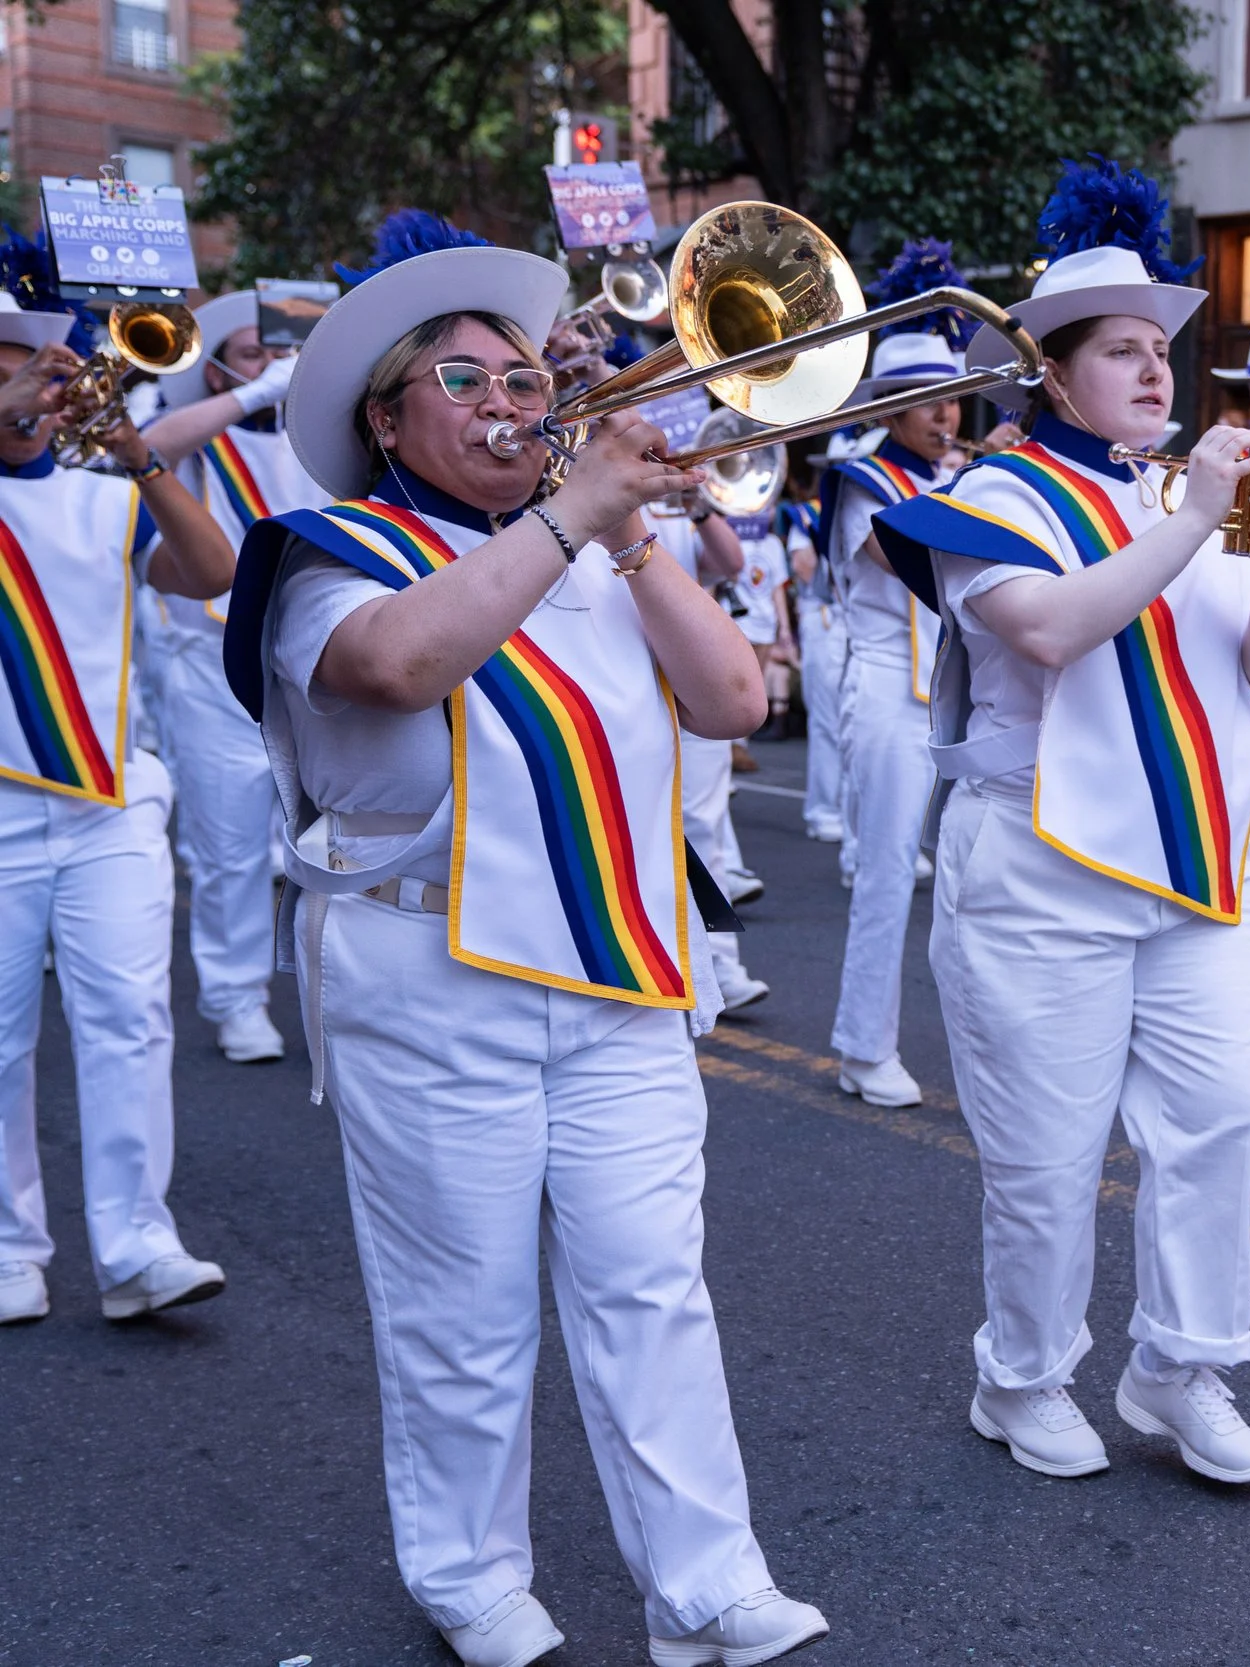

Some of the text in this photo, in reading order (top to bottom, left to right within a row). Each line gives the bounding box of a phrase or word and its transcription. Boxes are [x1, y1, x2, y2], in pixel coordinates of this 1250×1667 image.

[74, 200, 158, 217] THE QUEER
[50, 211, 186, 234] BIG APPLE CORPS
[54, 226, 185, 246] MARCHING BAND
[86, 263, 170, 279] QBAC.ORG
